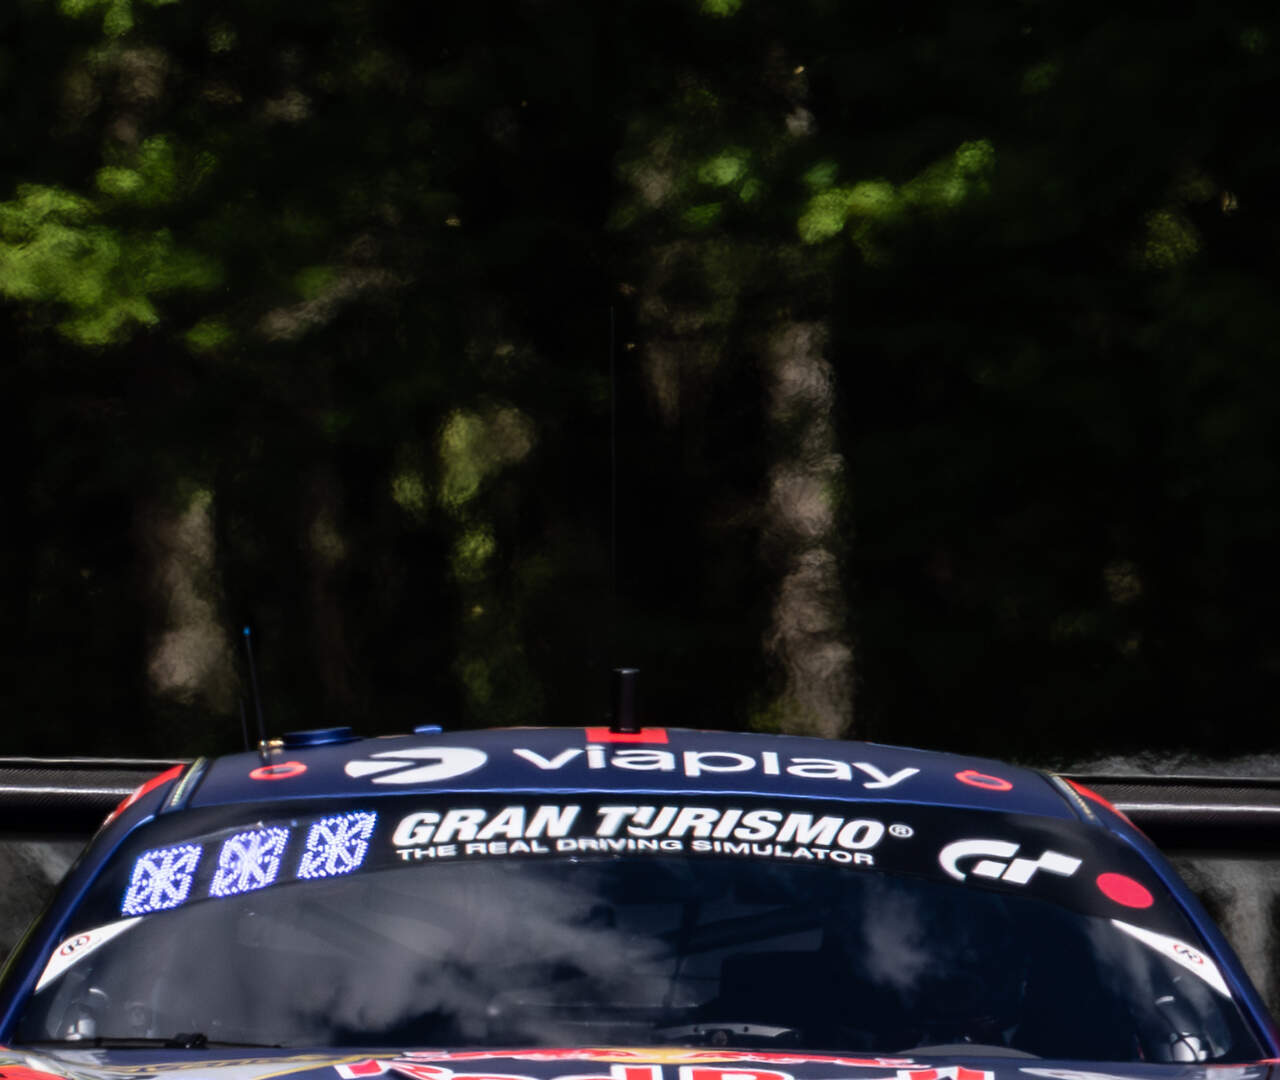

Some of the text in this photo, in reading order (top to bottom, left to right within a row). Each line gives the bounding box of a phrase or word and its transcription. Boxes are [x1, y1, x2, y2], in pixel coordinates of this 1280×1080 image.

[512, 743, 921, 789] viaplay
[391, 805, 581, 847] GRAN
[395, 838, 875, 865] THE REAL DRIVING SIMULATOR
